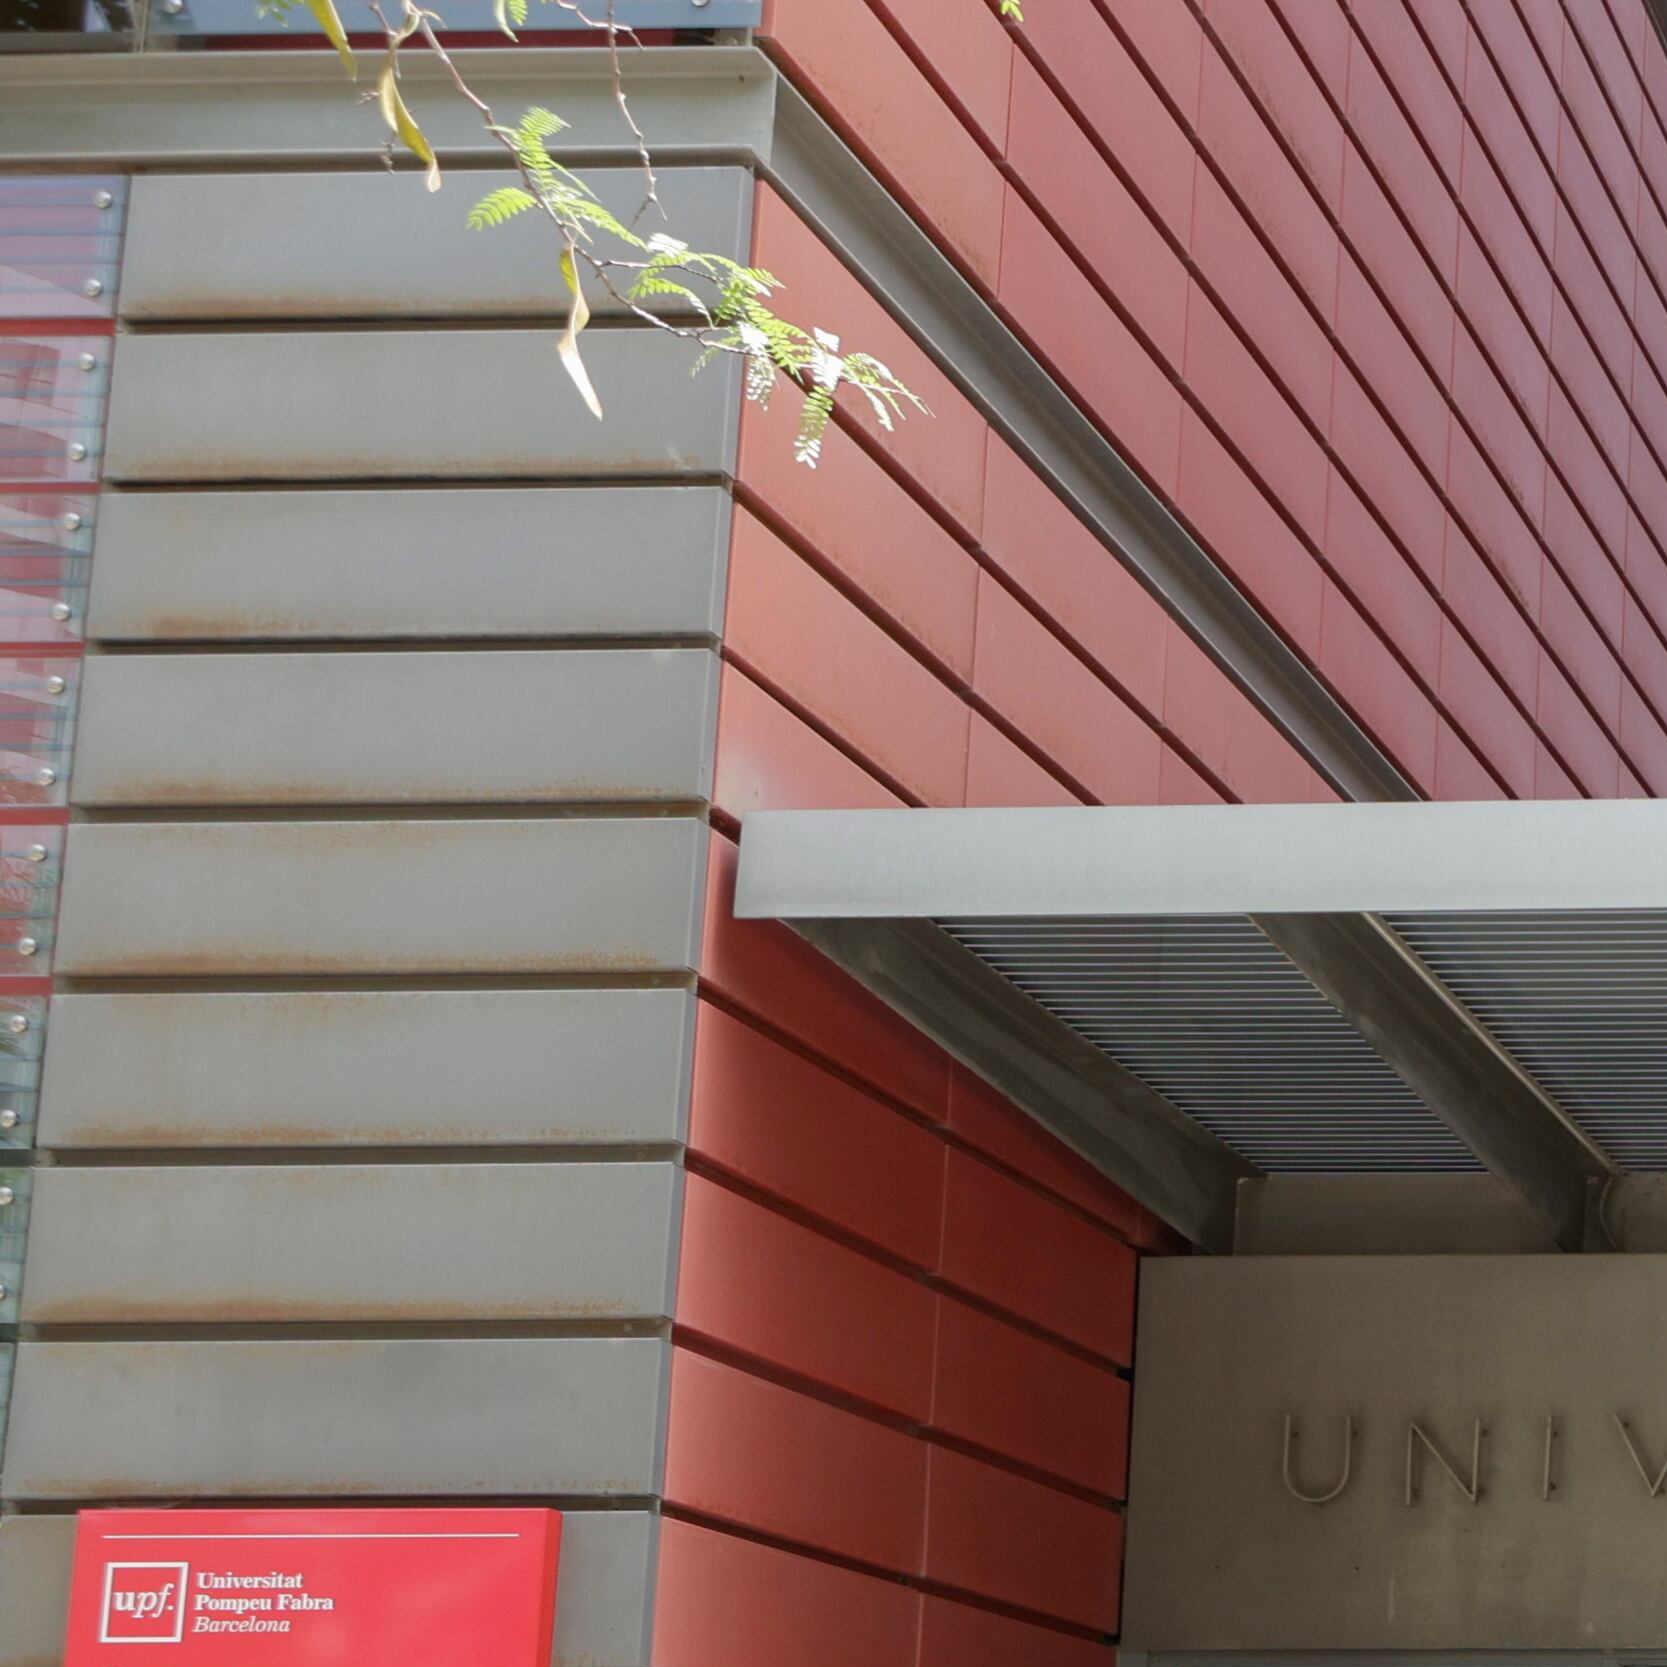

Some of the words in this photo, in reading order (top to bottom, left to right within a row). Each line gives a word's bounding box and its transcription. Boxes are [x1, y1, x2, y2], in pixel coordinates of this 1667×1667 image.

[196, 1572, 303, 1589] Universitat
[193, 1594, 273, 1614] Pompeu
[276, 1594, 334, 1611] Fabra
[191, 1615, 291, 1633] Barcelona
